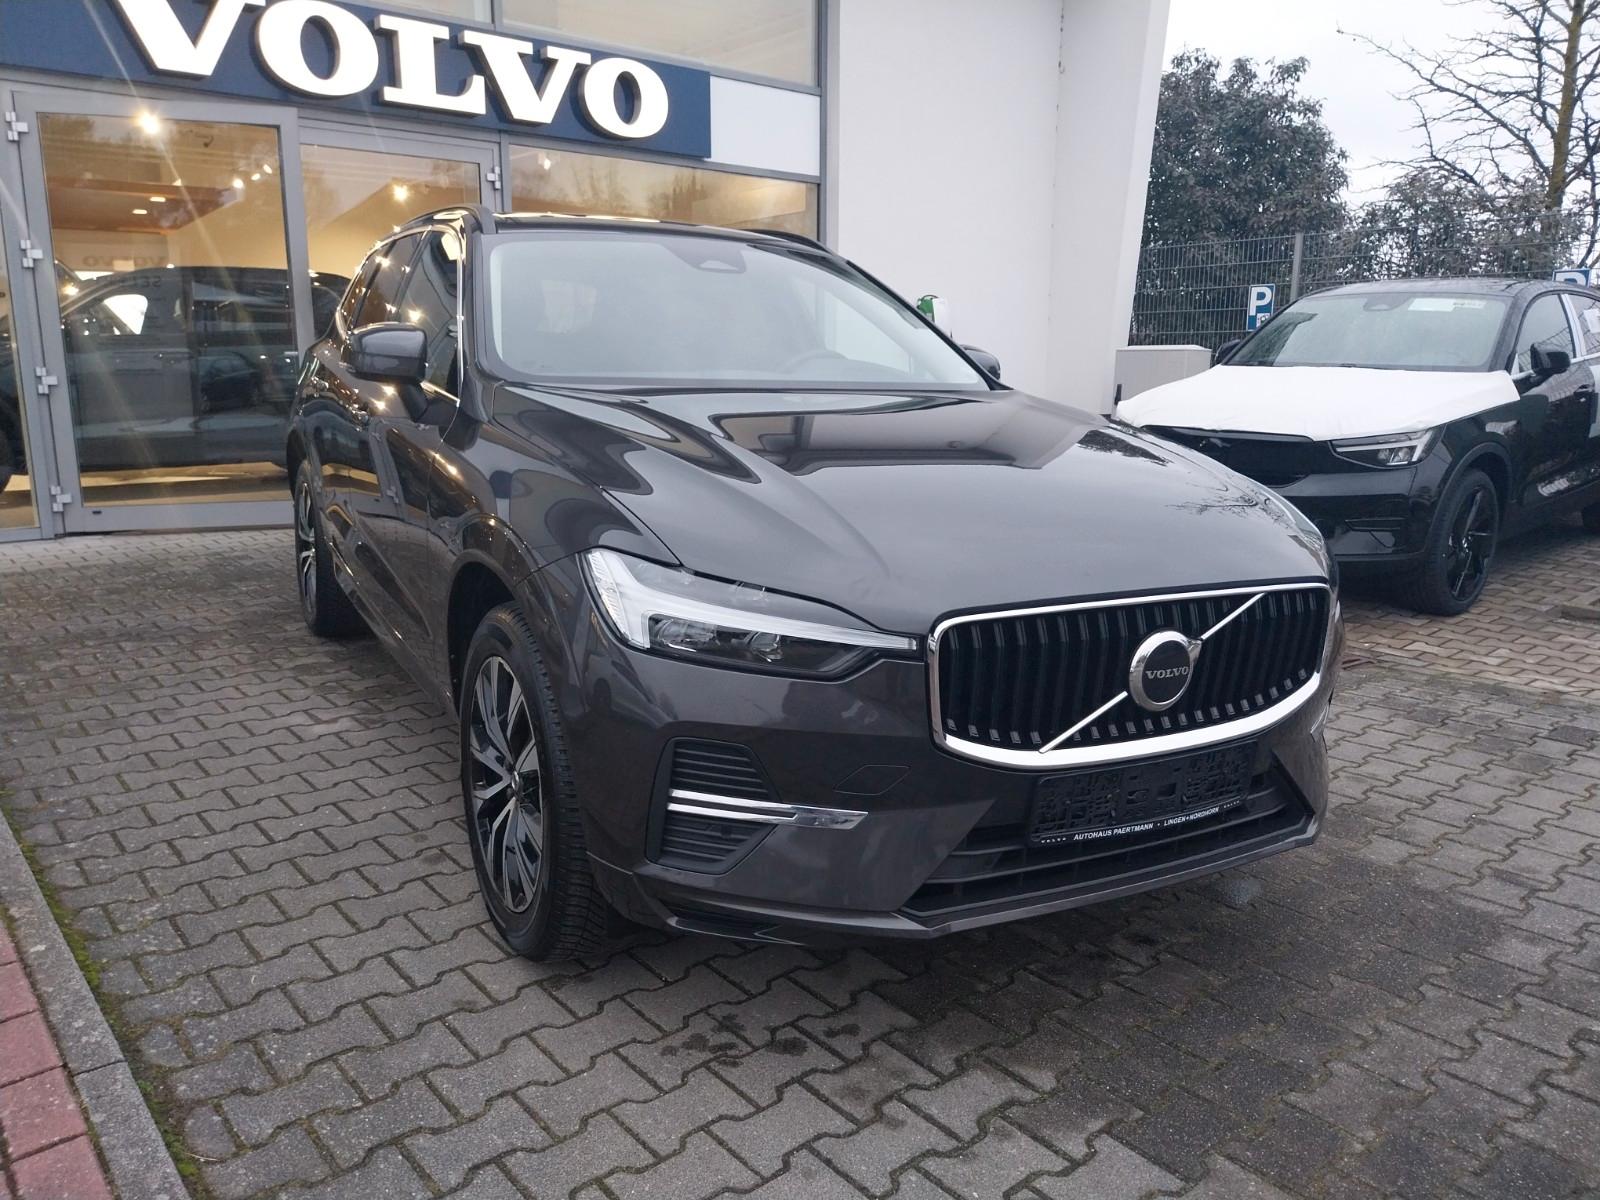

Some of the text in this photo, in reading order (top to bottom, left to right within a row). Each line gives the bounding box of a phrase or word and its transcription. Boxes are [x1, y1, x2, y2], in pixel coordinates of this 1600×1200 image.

[115, 0, 669, 140] VOLVO
[1250, 286, 1272, 316] P
[1145, 666, 1189, 679] VOLVO
[1074, 830, 1112, 840] AUTOHAUS
[1113, 823, 1154, 835] PAERTMANN
